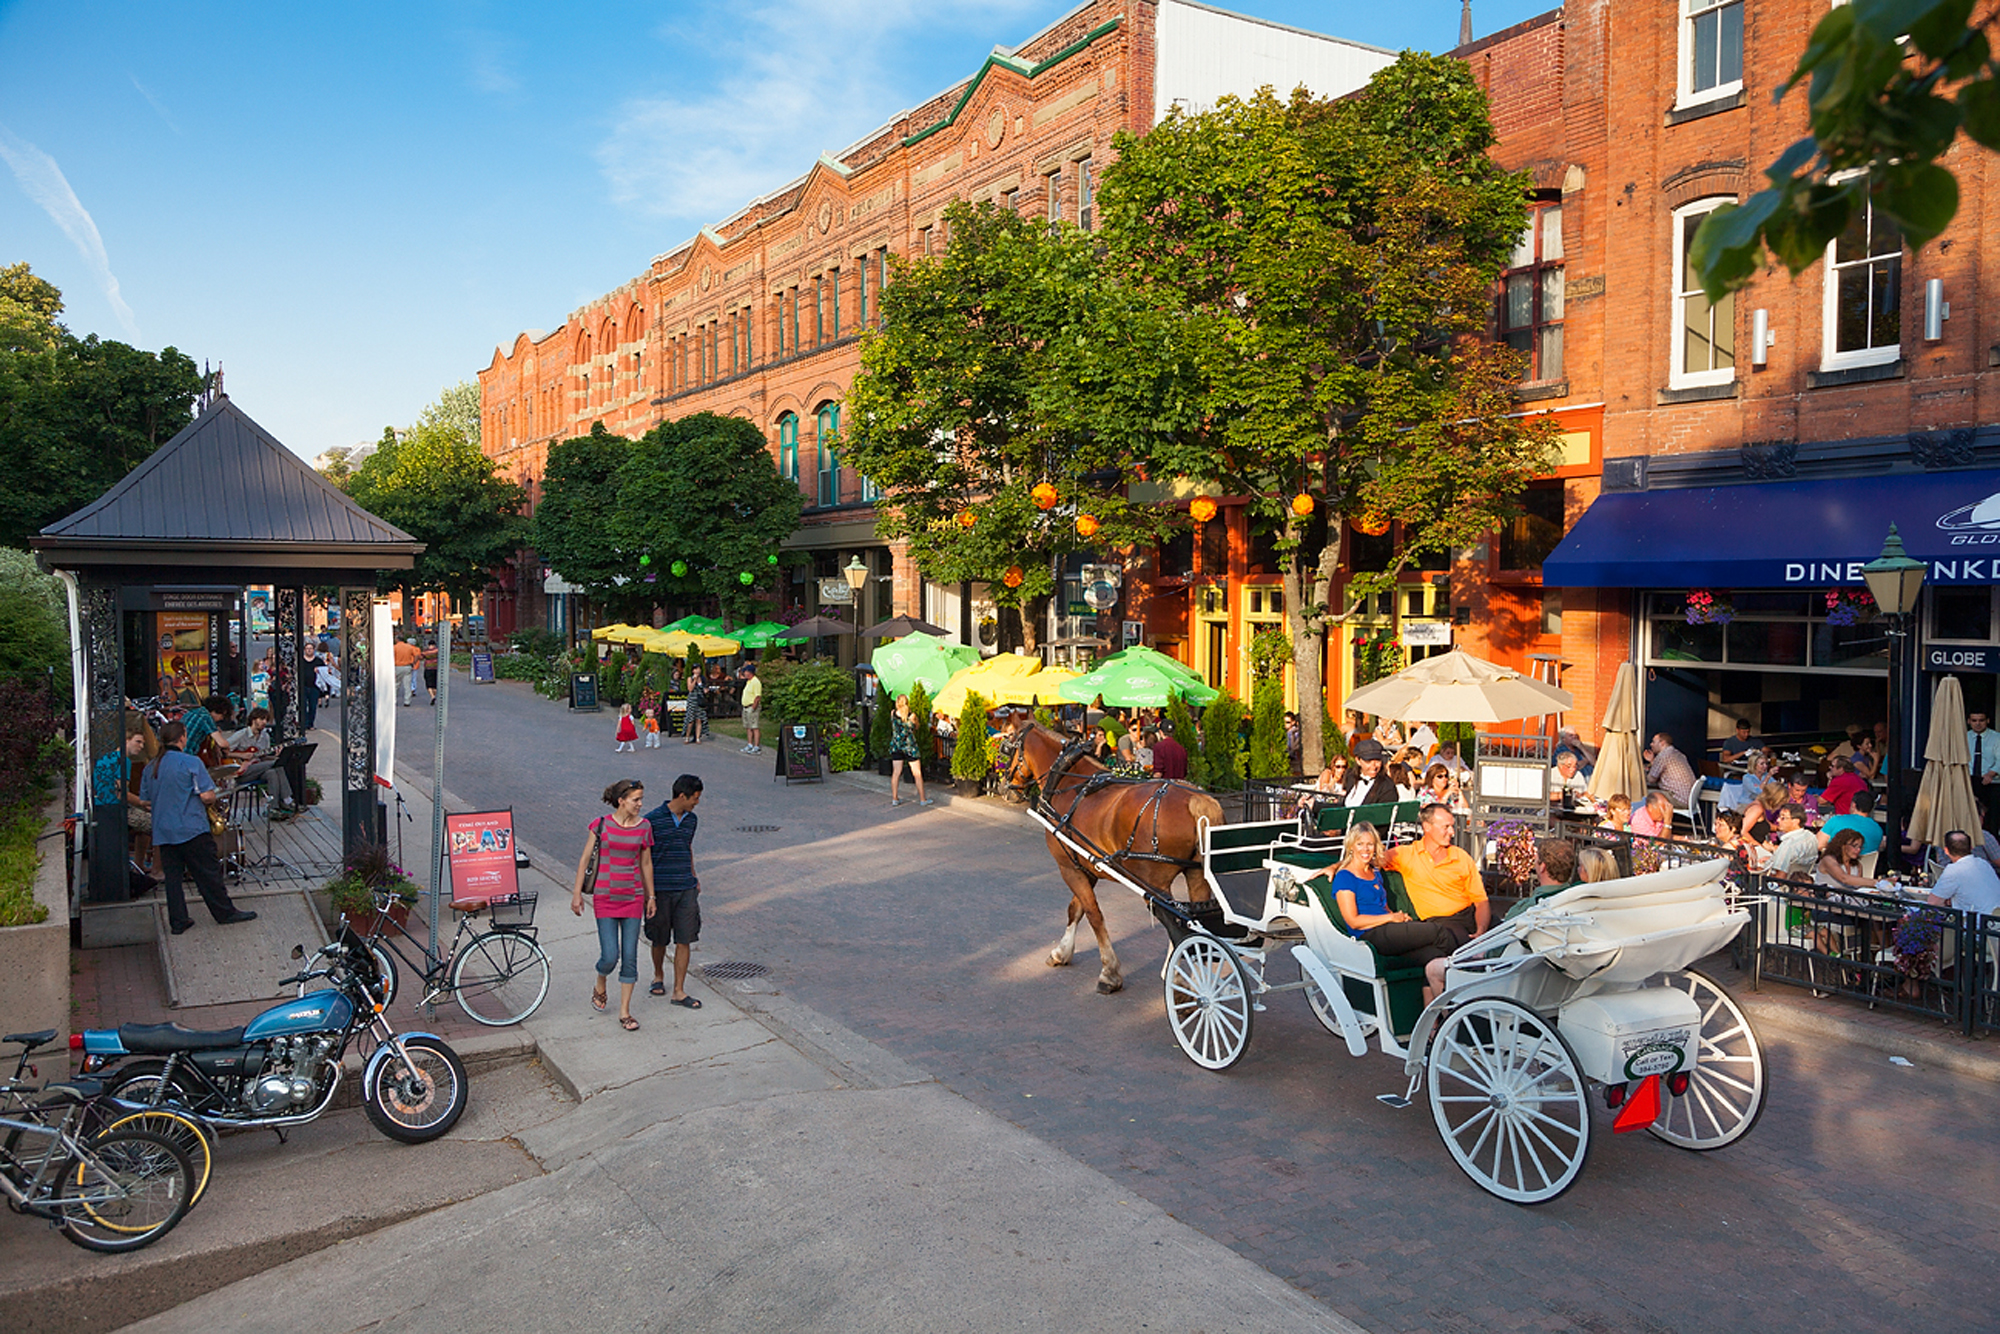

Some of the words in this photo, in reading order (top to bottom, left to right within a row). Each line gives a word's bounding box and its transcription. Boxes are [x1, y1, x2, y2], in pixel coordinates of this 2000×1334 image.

[1950, 534, 2000, 545] GLO
[1785, 562, 1865, 581] DINE
[1930, 650, 1986, 666] GLOBE
[451, 828, 511, 855] PLAY
[1635, 1057, 1649, 1066] Call
